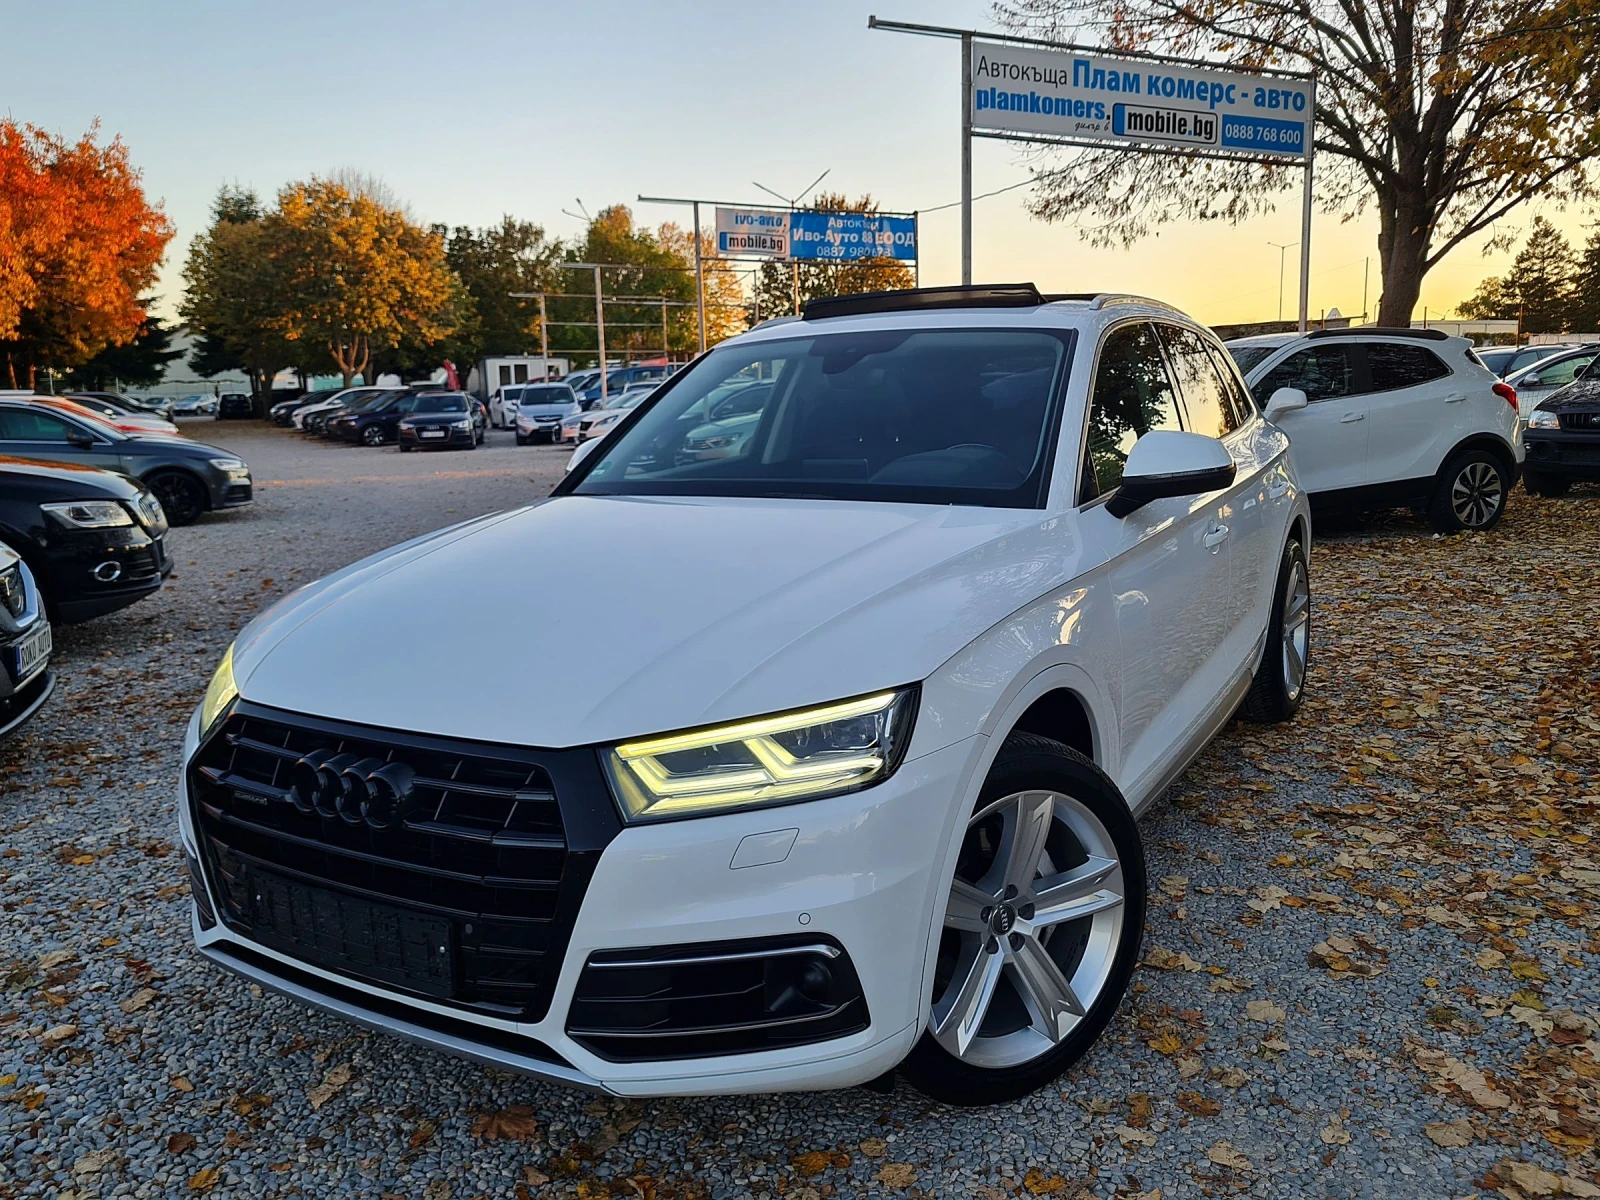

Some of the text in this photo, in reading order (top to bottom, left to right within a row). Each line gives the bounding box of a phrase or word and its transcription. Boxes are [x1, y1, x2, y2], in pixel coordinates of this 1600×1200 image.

[977, 55, 1067, 88] Автокъща
[1073, 59, 1140, 94] Плам
[1147, 74, 1236, 109] комерс
[1254, 87, 1305, 112] авто
[1127, 111, 1213, 140] mobile.bg
[1225, 123, 1300, 144] 0888 768 600
[729, 235, 782, 251] mobile.bg
[793, 228, 858, 246] Иво-Ауто
[875, 232, 914, 247] ЕООД
[817, 246, 845, 257] 0887
[850, 247, 871, 257] 980
